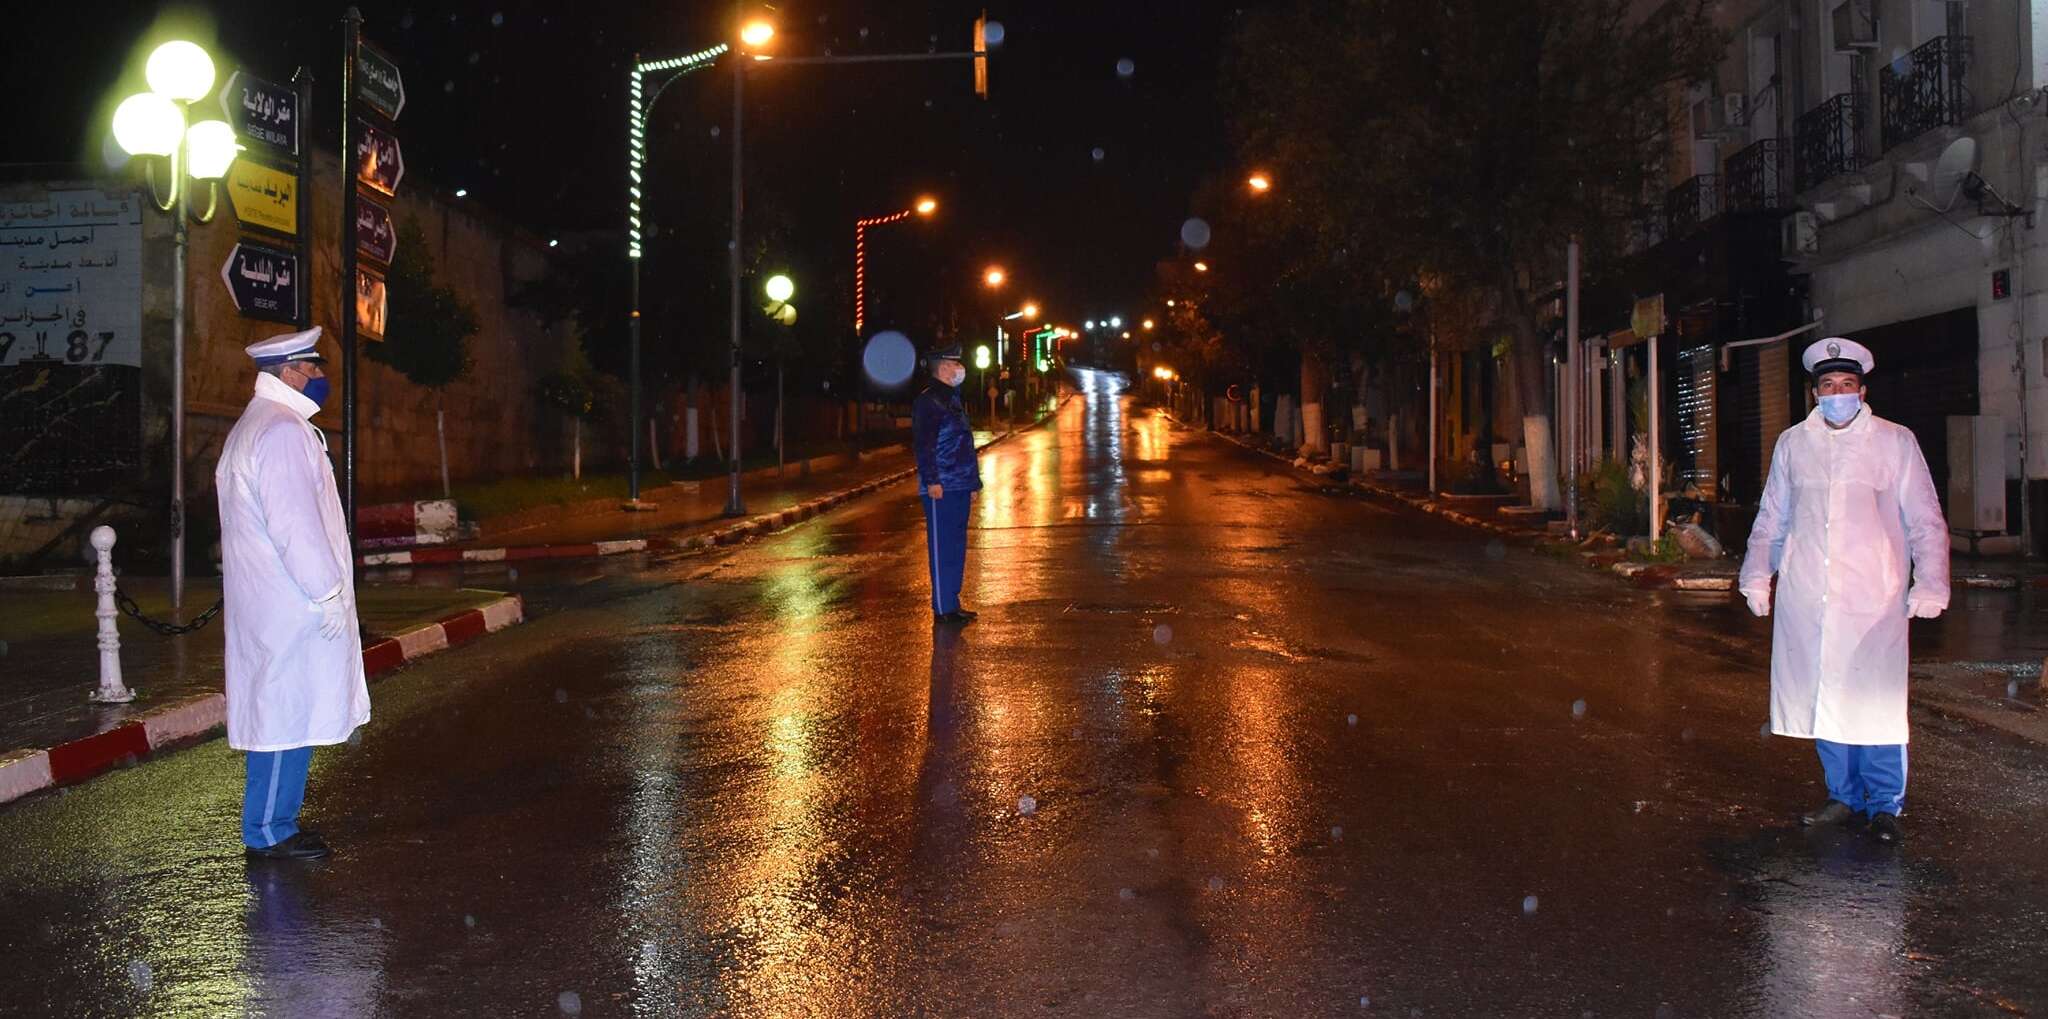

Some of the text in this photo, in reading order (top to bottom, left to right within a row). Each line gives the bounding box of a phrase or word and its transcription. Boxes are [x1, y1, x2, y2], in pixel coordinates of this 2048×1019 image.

[243, 88, 291, 124] مقر الولاية
[16, 256, 72, 273] مدينة
[240, 254, 291, 291] مقر البلدية
